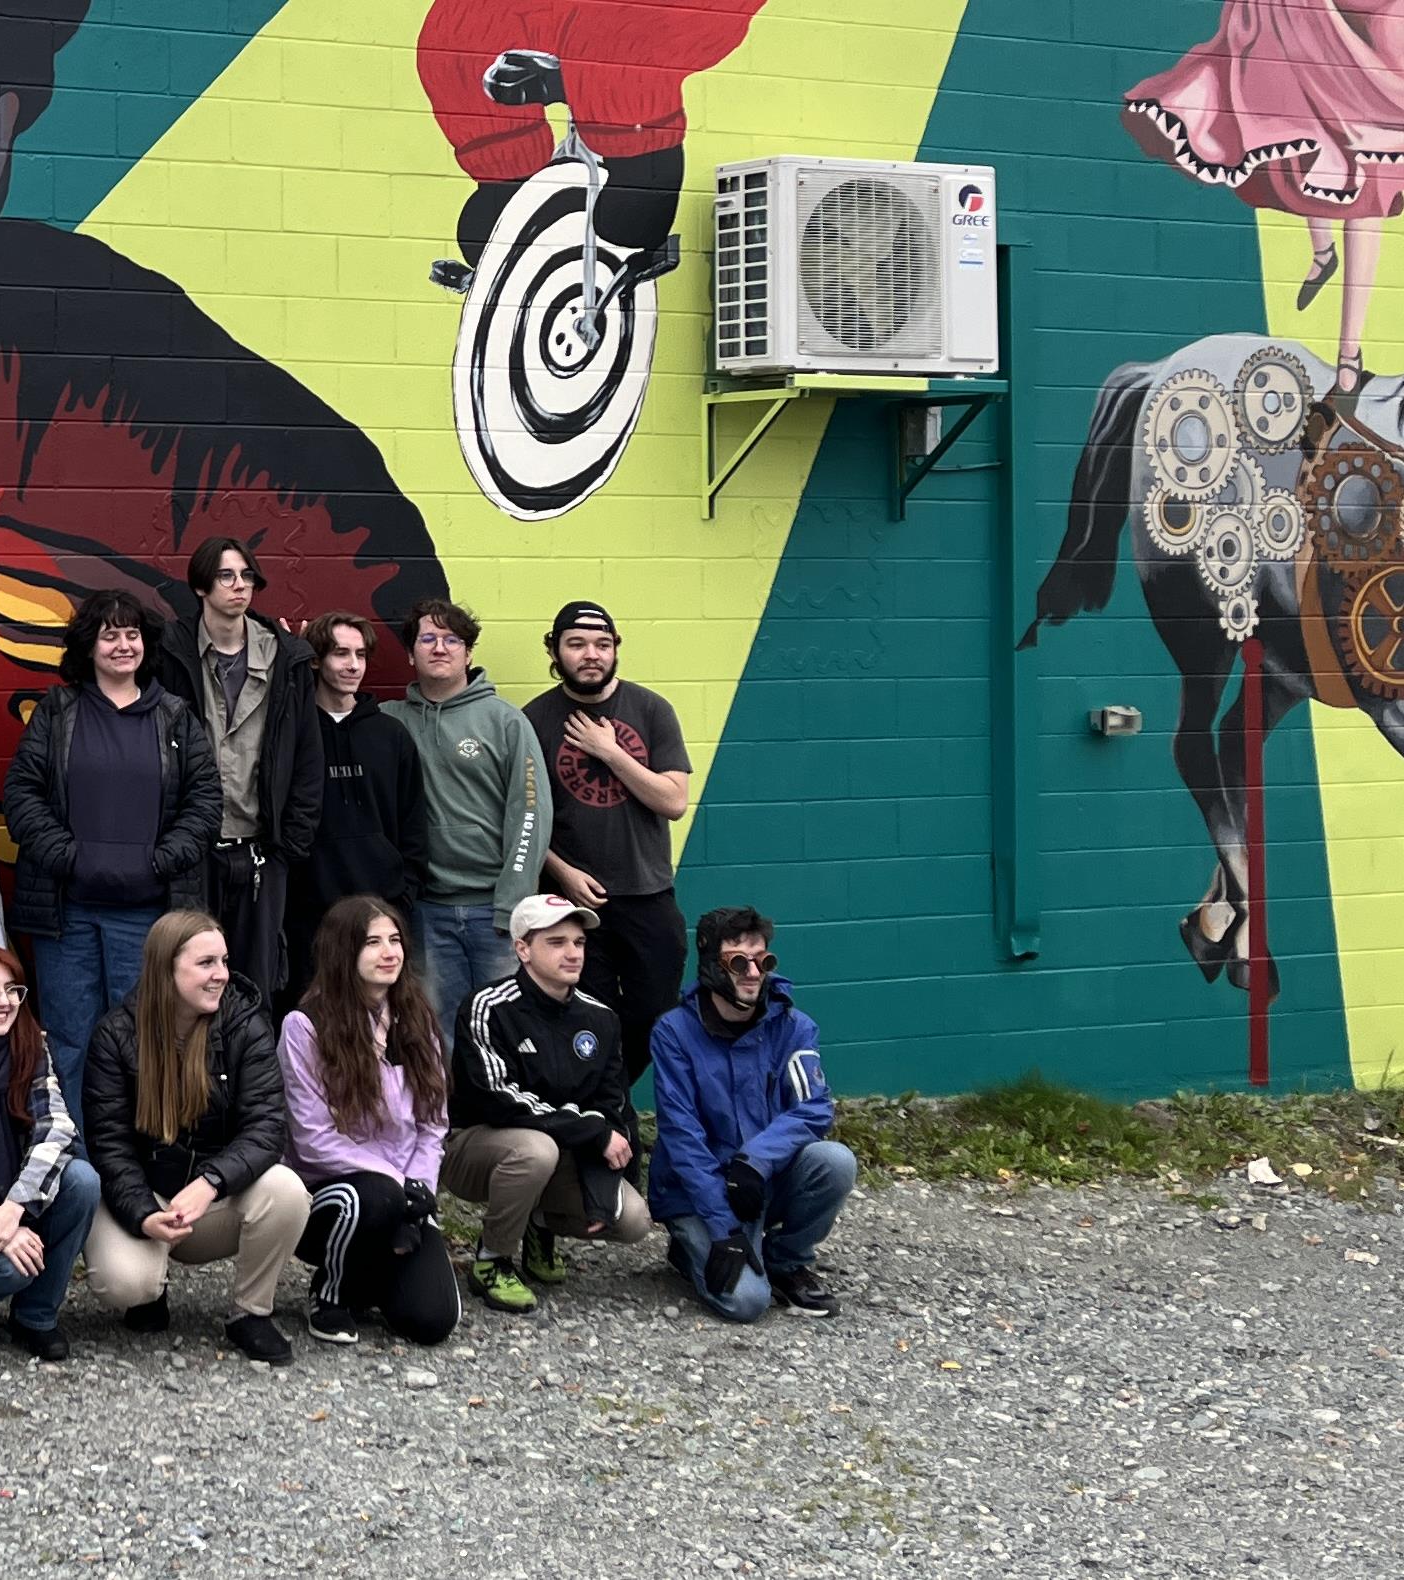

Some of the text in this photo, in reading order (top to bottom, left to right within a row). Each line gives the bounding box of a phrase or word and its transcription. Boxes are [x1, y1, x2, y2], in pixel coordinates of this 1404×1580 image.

[952, 213, 992, 227] GREE
[559, 755, 584, 792] RED
[512, 811, 535, 873] BRIXTON
